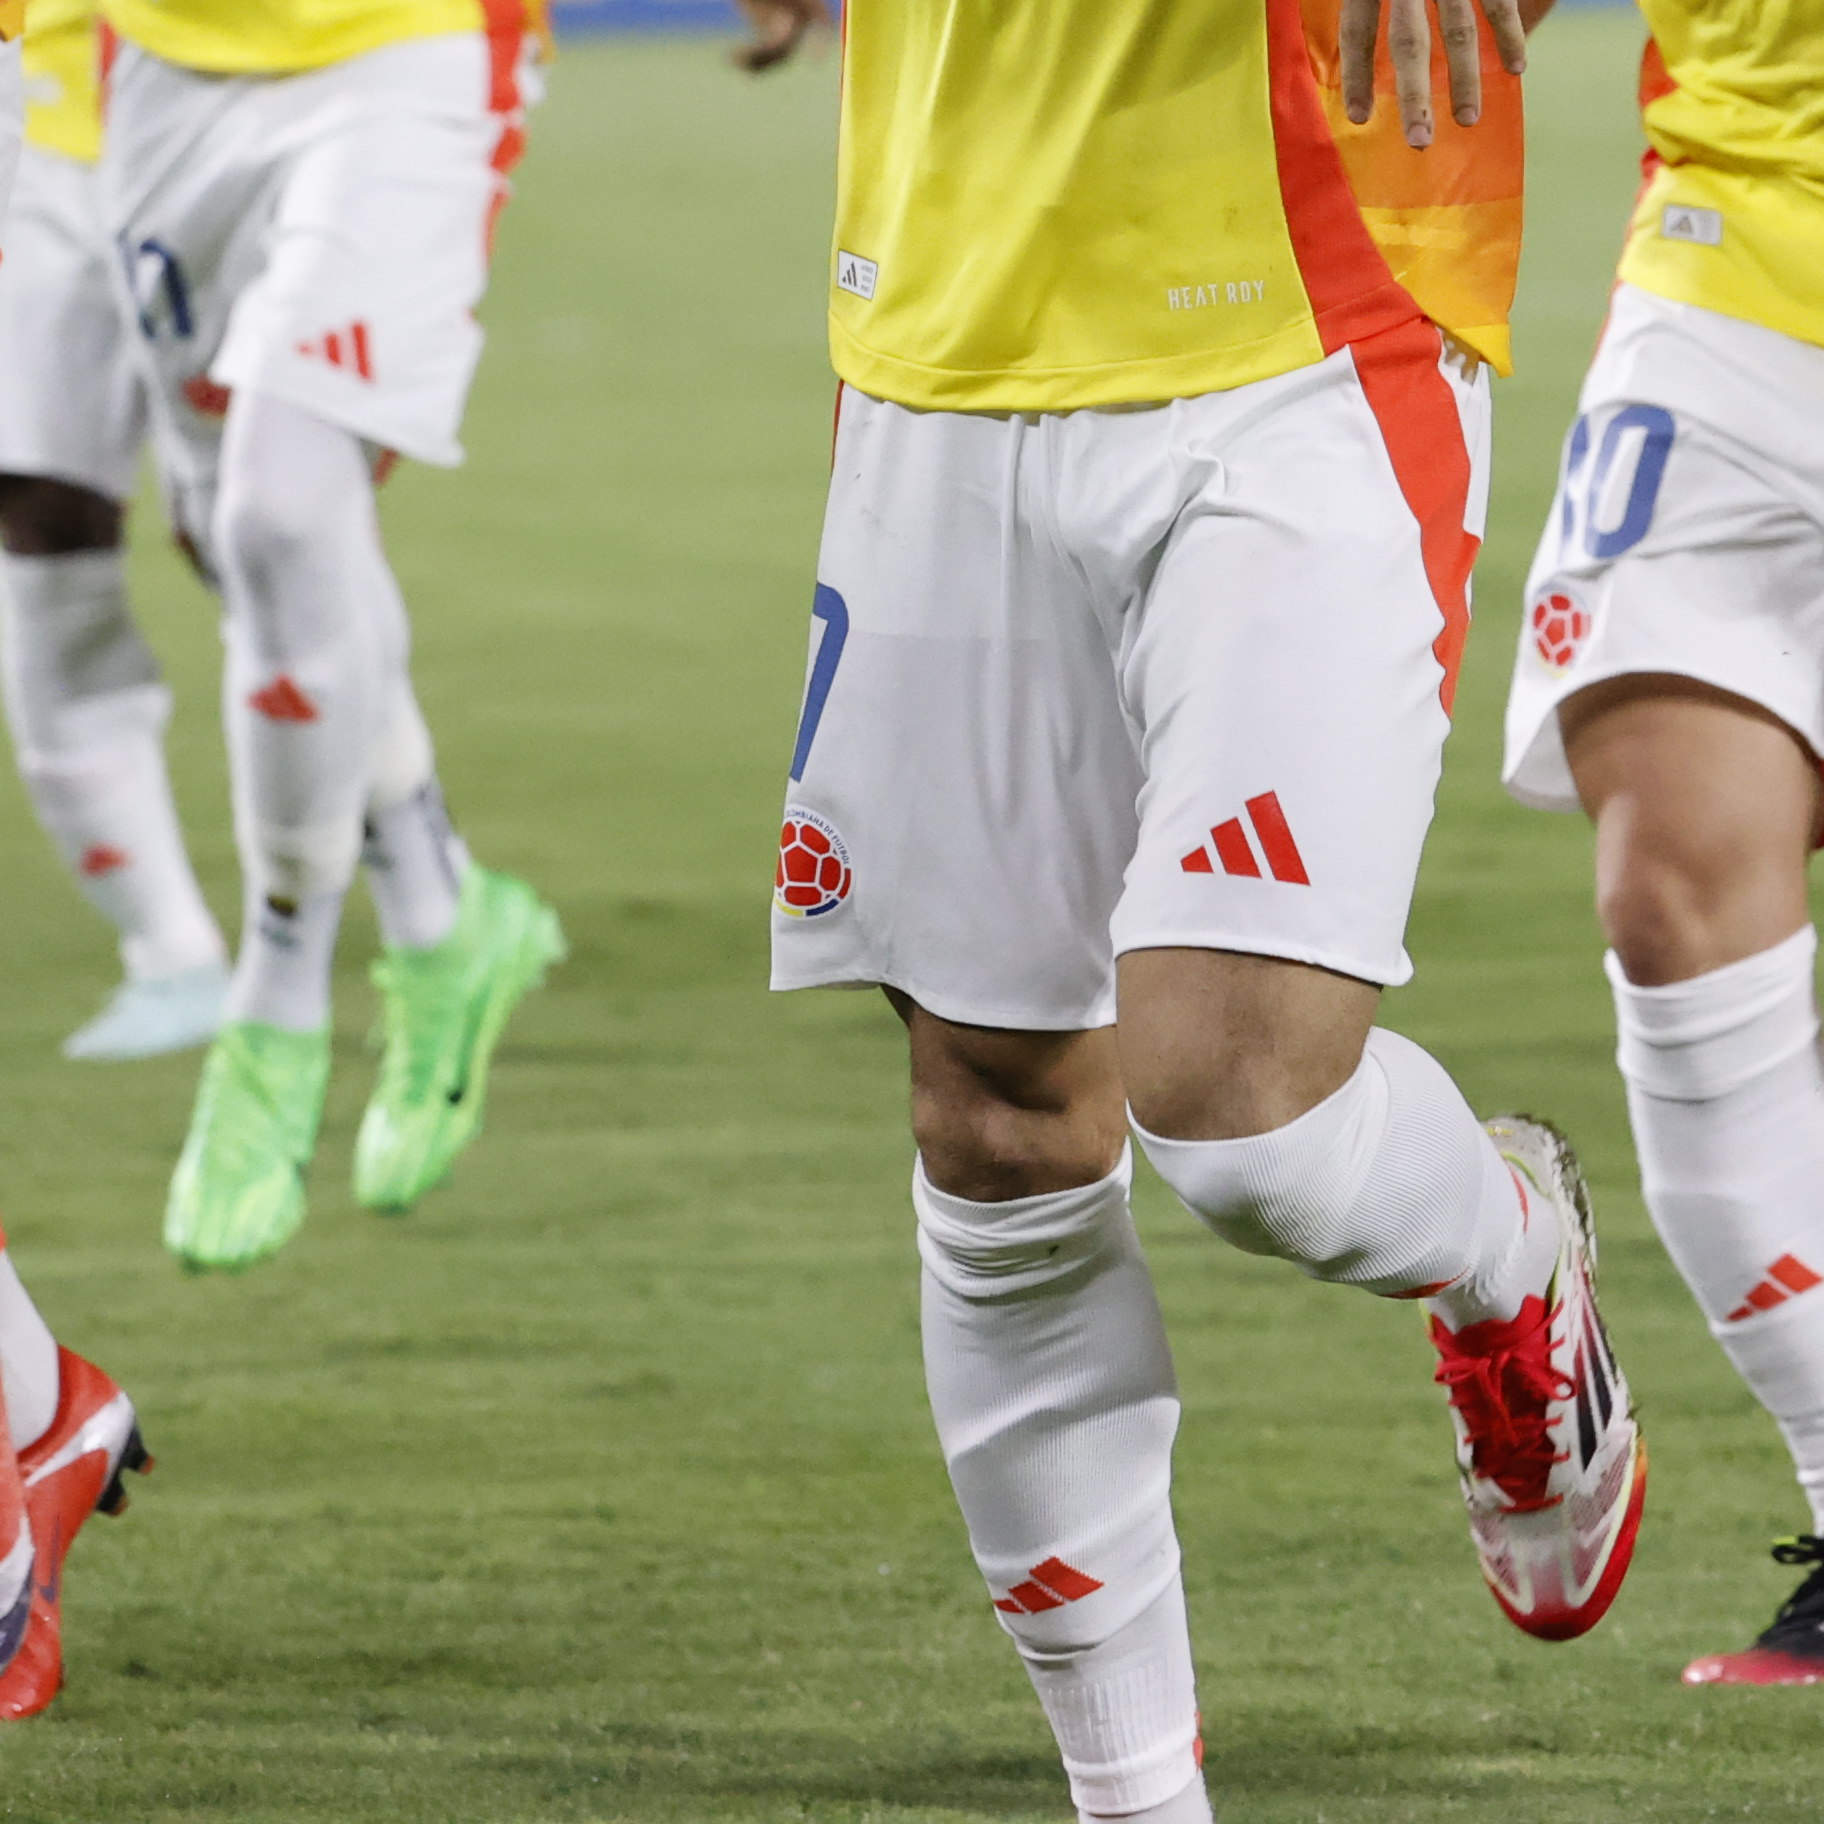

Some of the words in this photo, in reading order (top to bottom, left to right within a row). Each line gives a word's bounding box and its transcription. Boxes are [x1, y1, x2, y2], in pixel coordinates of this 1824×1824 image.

[1167, 283, 1218, 311] HEAT
[1225, 279, 1265, 305] RDY
[788, 579, 849, 783] 7
